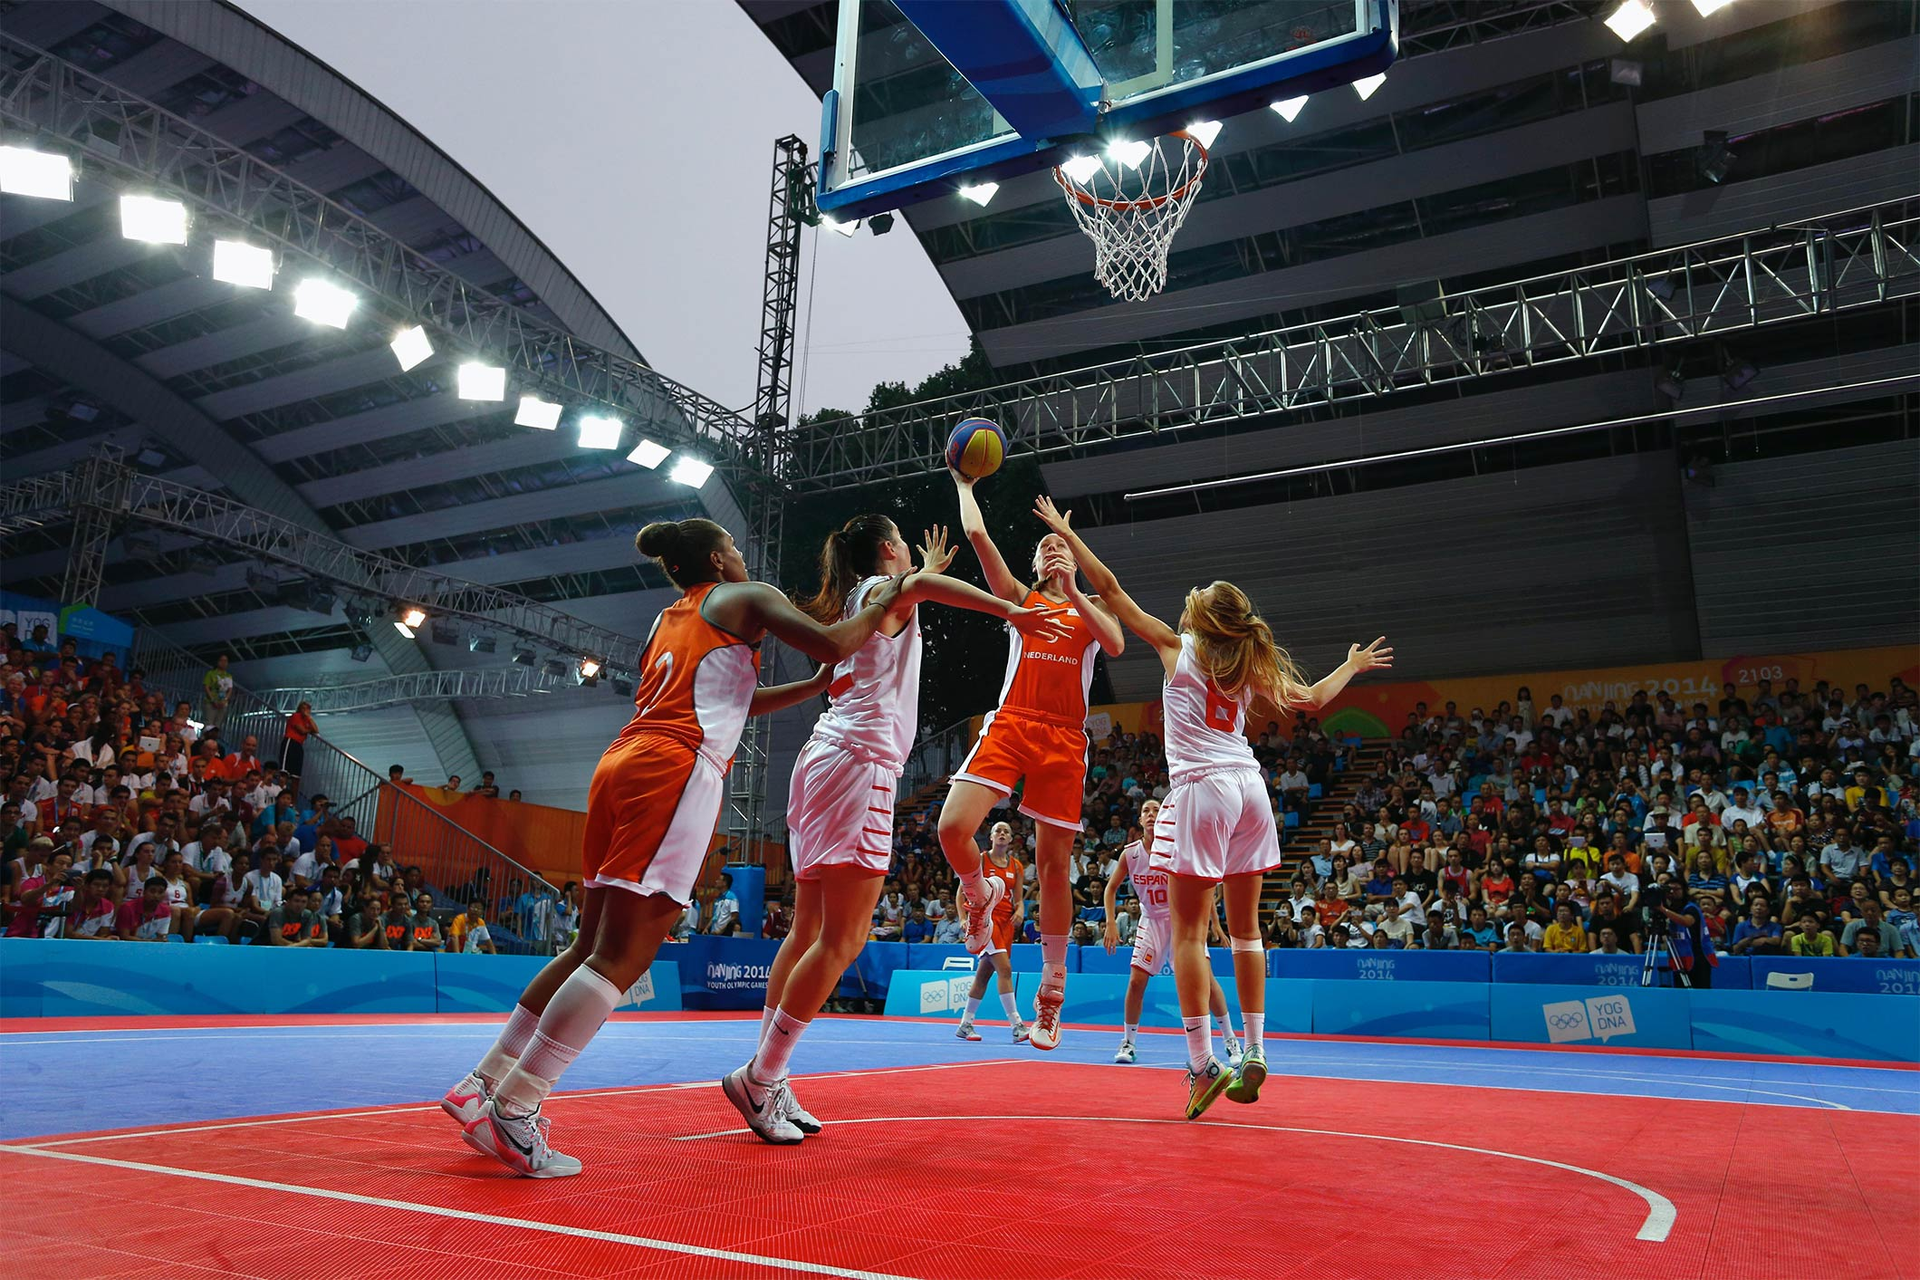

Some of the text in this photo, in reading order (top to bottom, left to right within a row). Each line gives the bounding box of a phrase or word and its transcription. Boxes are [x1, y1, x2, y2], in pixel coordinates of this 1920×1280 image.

[1023, 651, 1079, 667] NEDERLAND
[1738, 666, 1784, 684] 2103
[1645, 675, 1717, 697] 2014
[1133, 872, 1169, 886] ESPAÑ
[1146, 889, 1168, 905] 10
[1359, 970, 1394, 980] 2014
[1597, 976, 1638, 987] 2014
[1876, 968, 1920, 983] NANJIN
[634, 984, 651, 997] DNA
[707, 981, 726, 989] YOUTH
[727, 981, 750, 990] OLYMPIC
[1880, 983, 1920, 994] 201
[953, 993, 968, 1004] DN
[1594, 1002, 1623, 1016] YOG
[1597, 1016, 1626, 1030] DNA
